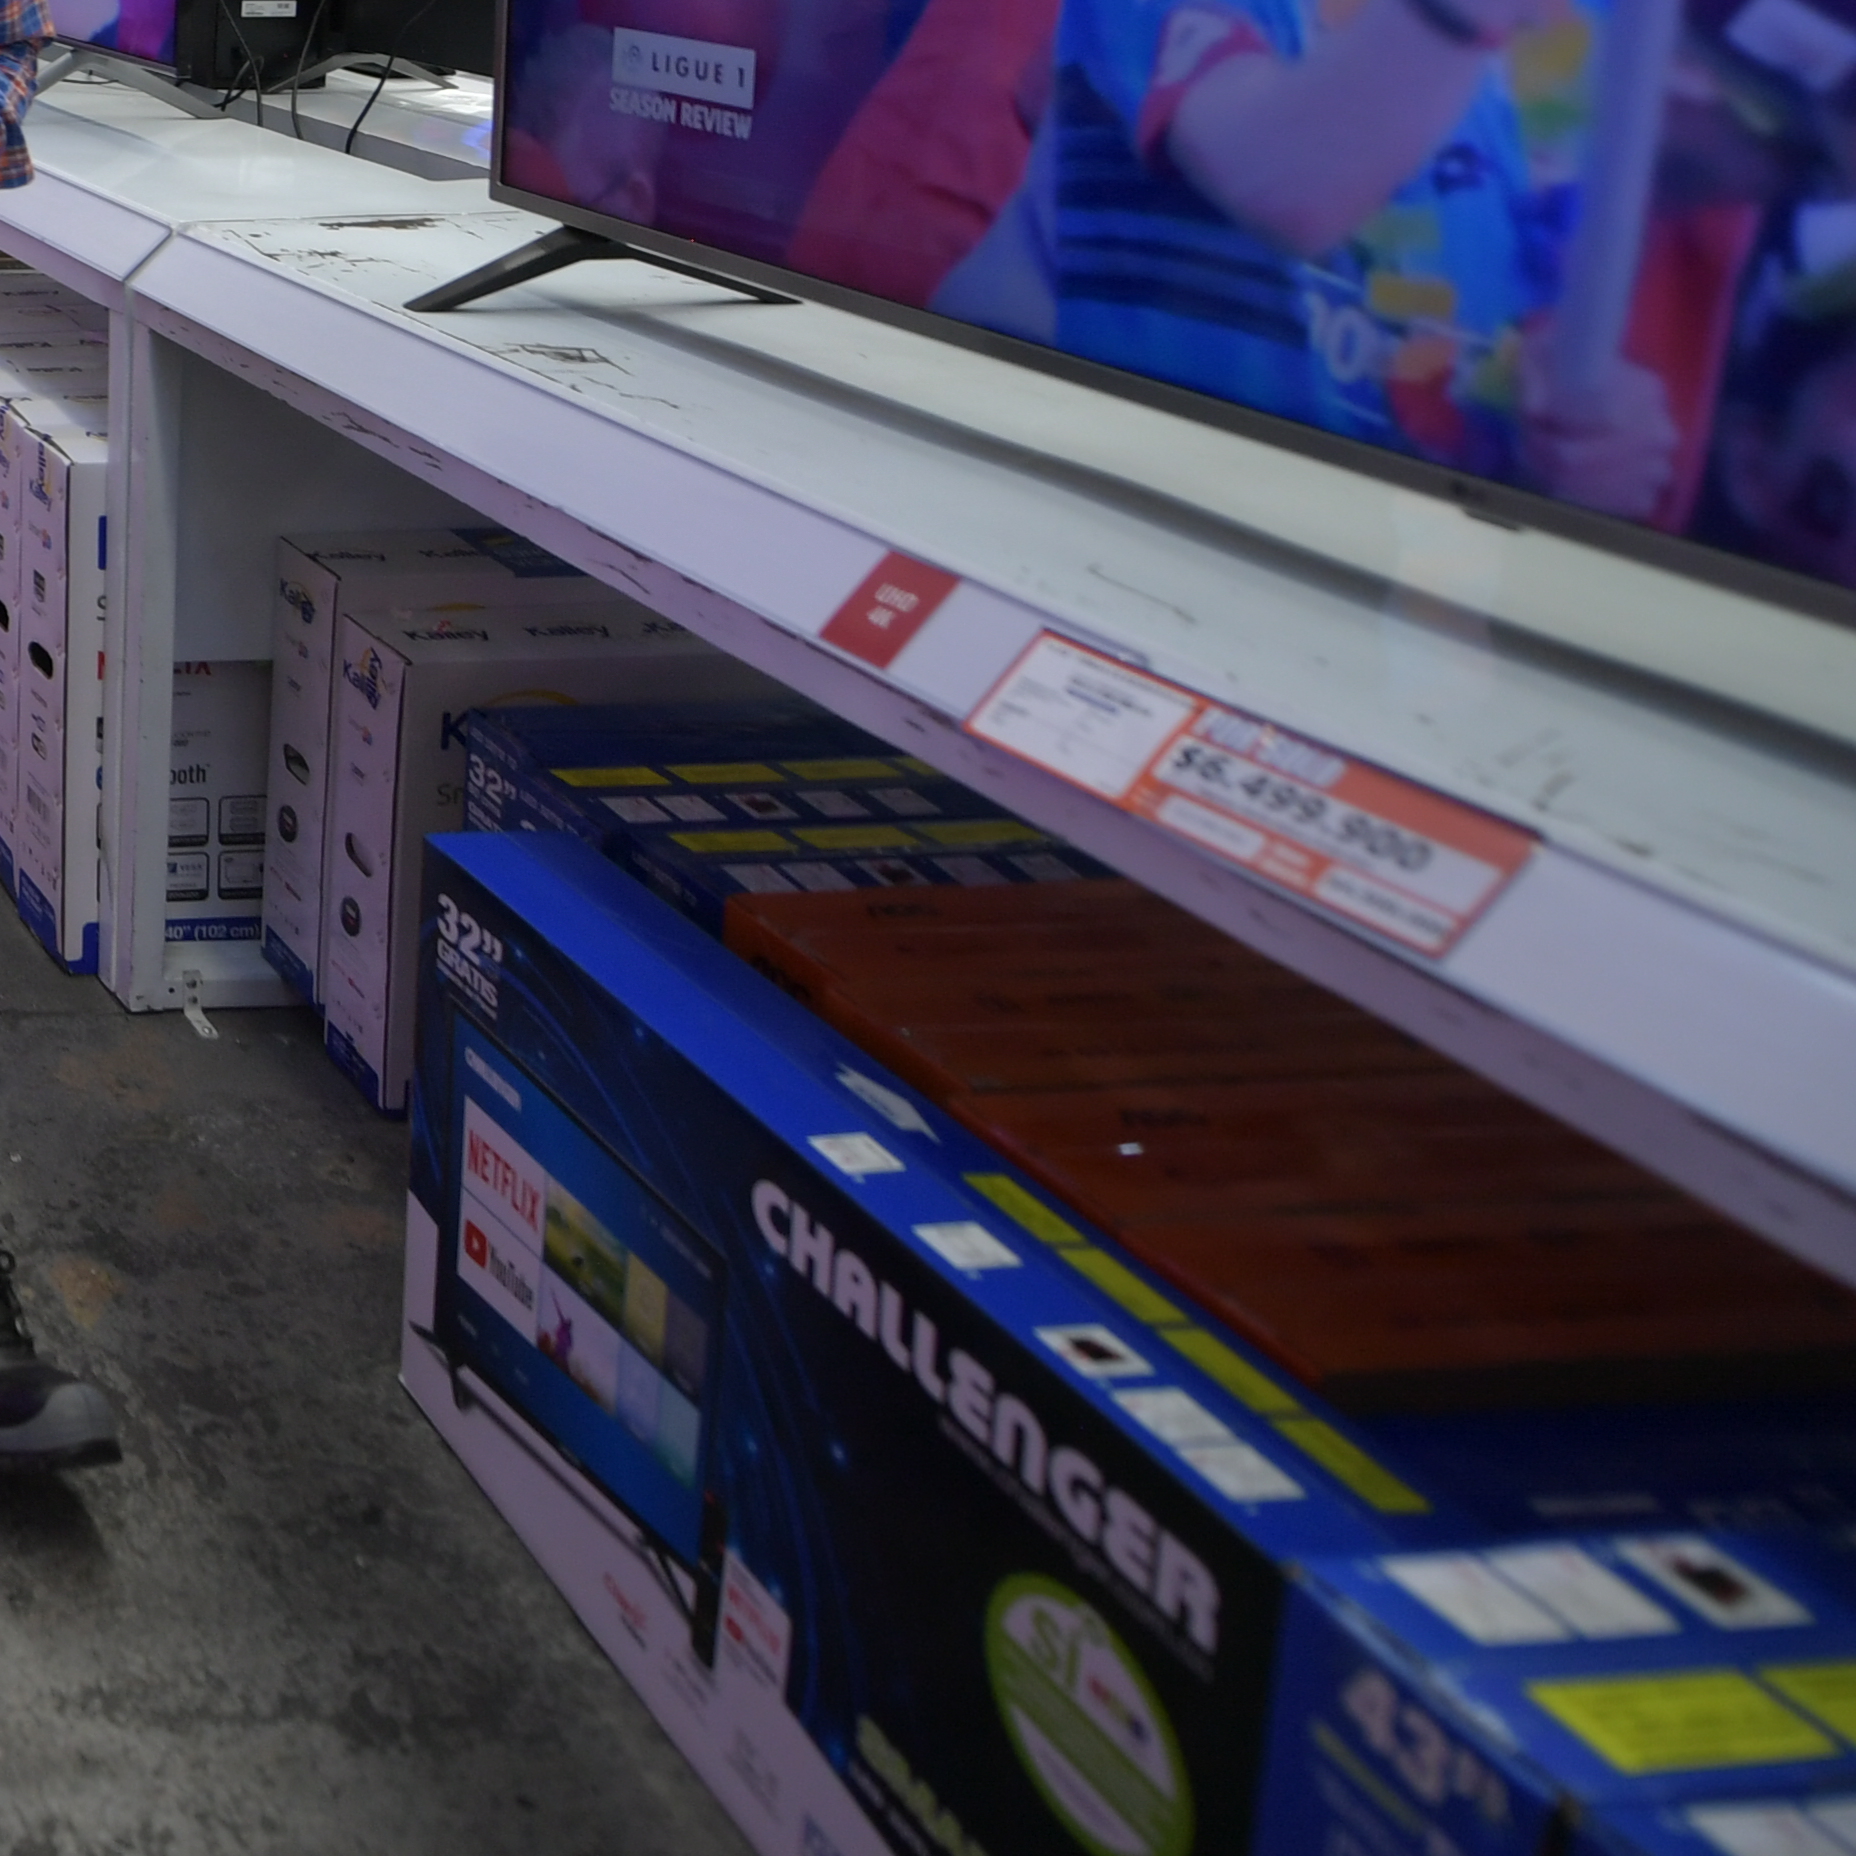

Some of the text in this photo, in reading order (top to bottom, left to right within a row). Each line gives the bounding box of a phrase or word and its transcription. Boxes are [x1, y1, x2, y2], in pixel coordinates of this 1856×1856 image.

[651, 51, 745, 89] LIGUE 1
[610, 86, 754, 141] SEASON REVIEW
[193, 919, 228, 941] (102
[435, 940, 500, 1010] GRATIS
[466, 1126, 543, 1234] NETFLIX
[750, 1178, 1224, 1658] CHALLENGER
